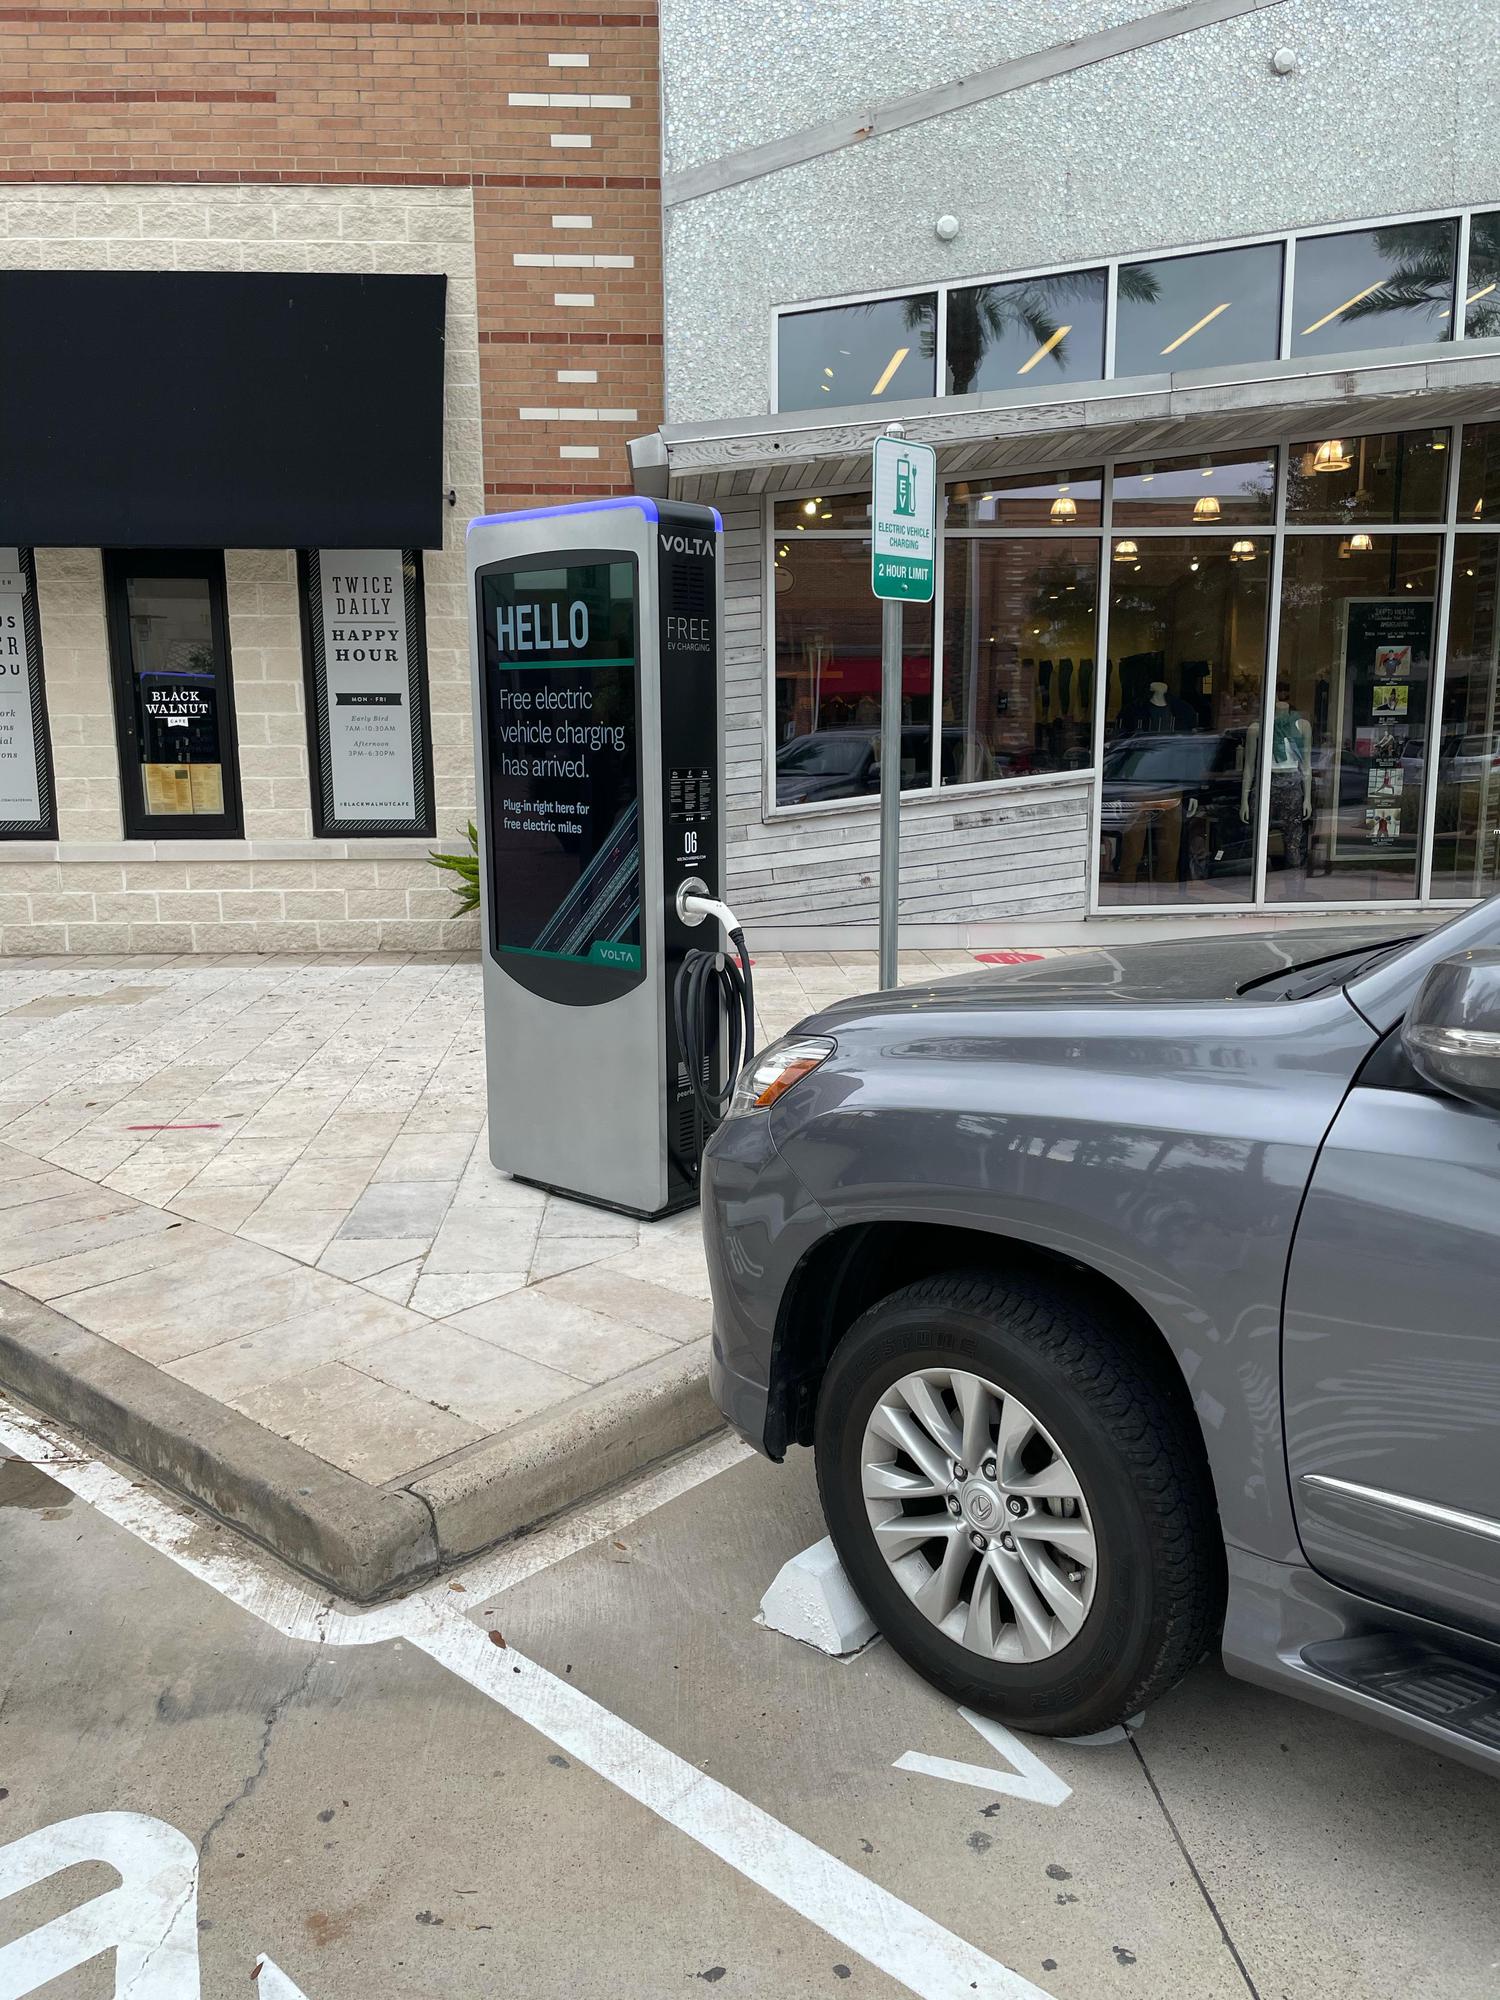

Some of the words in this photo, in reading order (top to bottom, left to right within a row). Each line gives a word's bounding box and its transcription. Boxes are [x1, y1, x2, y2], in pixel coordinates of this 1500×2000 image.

[878, 521, 906, 535] ELECTRIC
[906, 525, 930, 539] VEHICLE
[660, 534, 714, 557] VOLTA
[889, 536, 919, 550] CHARGING
[878, 562, 885, 577] 2
[886, 564, 907, 579] HOUR
[908, 566, 929, 580] LIMIT
[332, 576, 393, 594] TWICE
[336, 598, 391, 615] DAILY
[496, 600, 589, 651] HELLO
[667, 616, 711, 641] FREE
[331, 629, 400, 641] HAPPY
[335, 648, 399, 662] HOUR
[667, 641, 676, 651] EV
[677, 642, 711, 652] CHARGING
[151, 691, 200, 702] BLACK
[499, 688, 532, 710] Free
[535, 685, 593, 710] electric
[145, 703, 209, 714] WALNUT
[351, 714, 372, 723] Early
[373, 714, 389, 722] Bird
[353, 740, 390, 748] Afternoon
[500, 719, 552, 743] vehicle
[556, 720, 626, 752] charging
[502, 752, 529, 776] has
[532, 754, 590, 778] arrived.
[503, 798, 532, 814] Plug-in
[533, 800, 554, 816] right
[555, 801, 575, 814] here
[576, 802, 590, 815] for
[503, 817, 521, 830] free
[523, 818, 556, 833] electric
[557, 820, 583, 834] miles
[684, 831, 698, 854] 06
[600, 949, 634, 963] VOLTA
